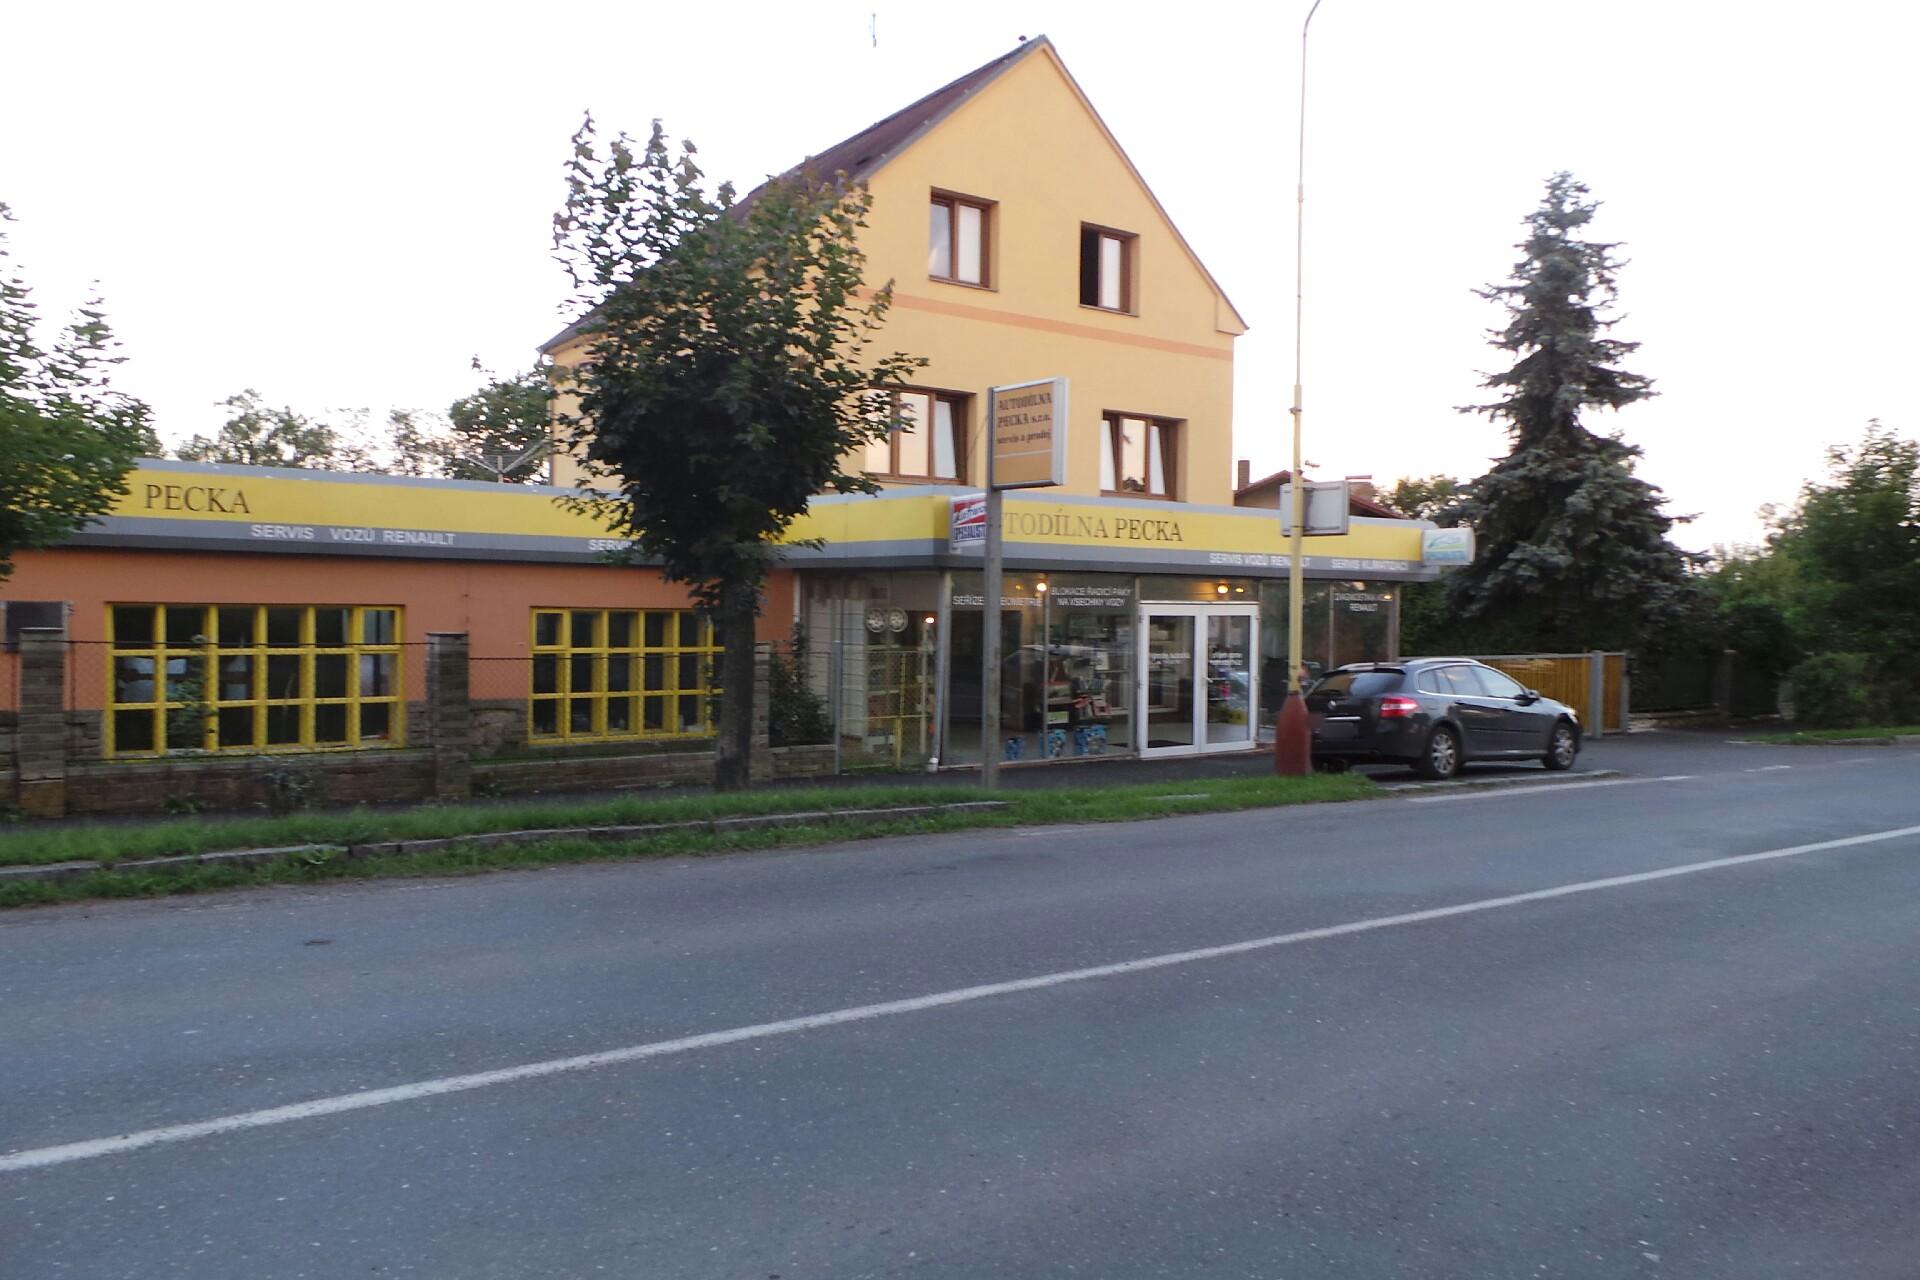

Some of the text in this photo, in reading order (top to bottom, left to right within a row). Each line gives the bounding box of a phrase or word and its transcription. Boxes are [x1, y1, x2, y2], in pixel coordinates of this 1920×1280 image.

[998, 414, 1029, 428] PECKA
[144, 483, 251, 514] PECKA
[250, 523, 315, 540] SERVIS
[383, 530, 456, 545] RENAULT
[1114, 517, 1184, 542] PECKA
[1209, 552, 1242, 564] SERVIS
[1331, 558, 1360, 569] SERVIS
